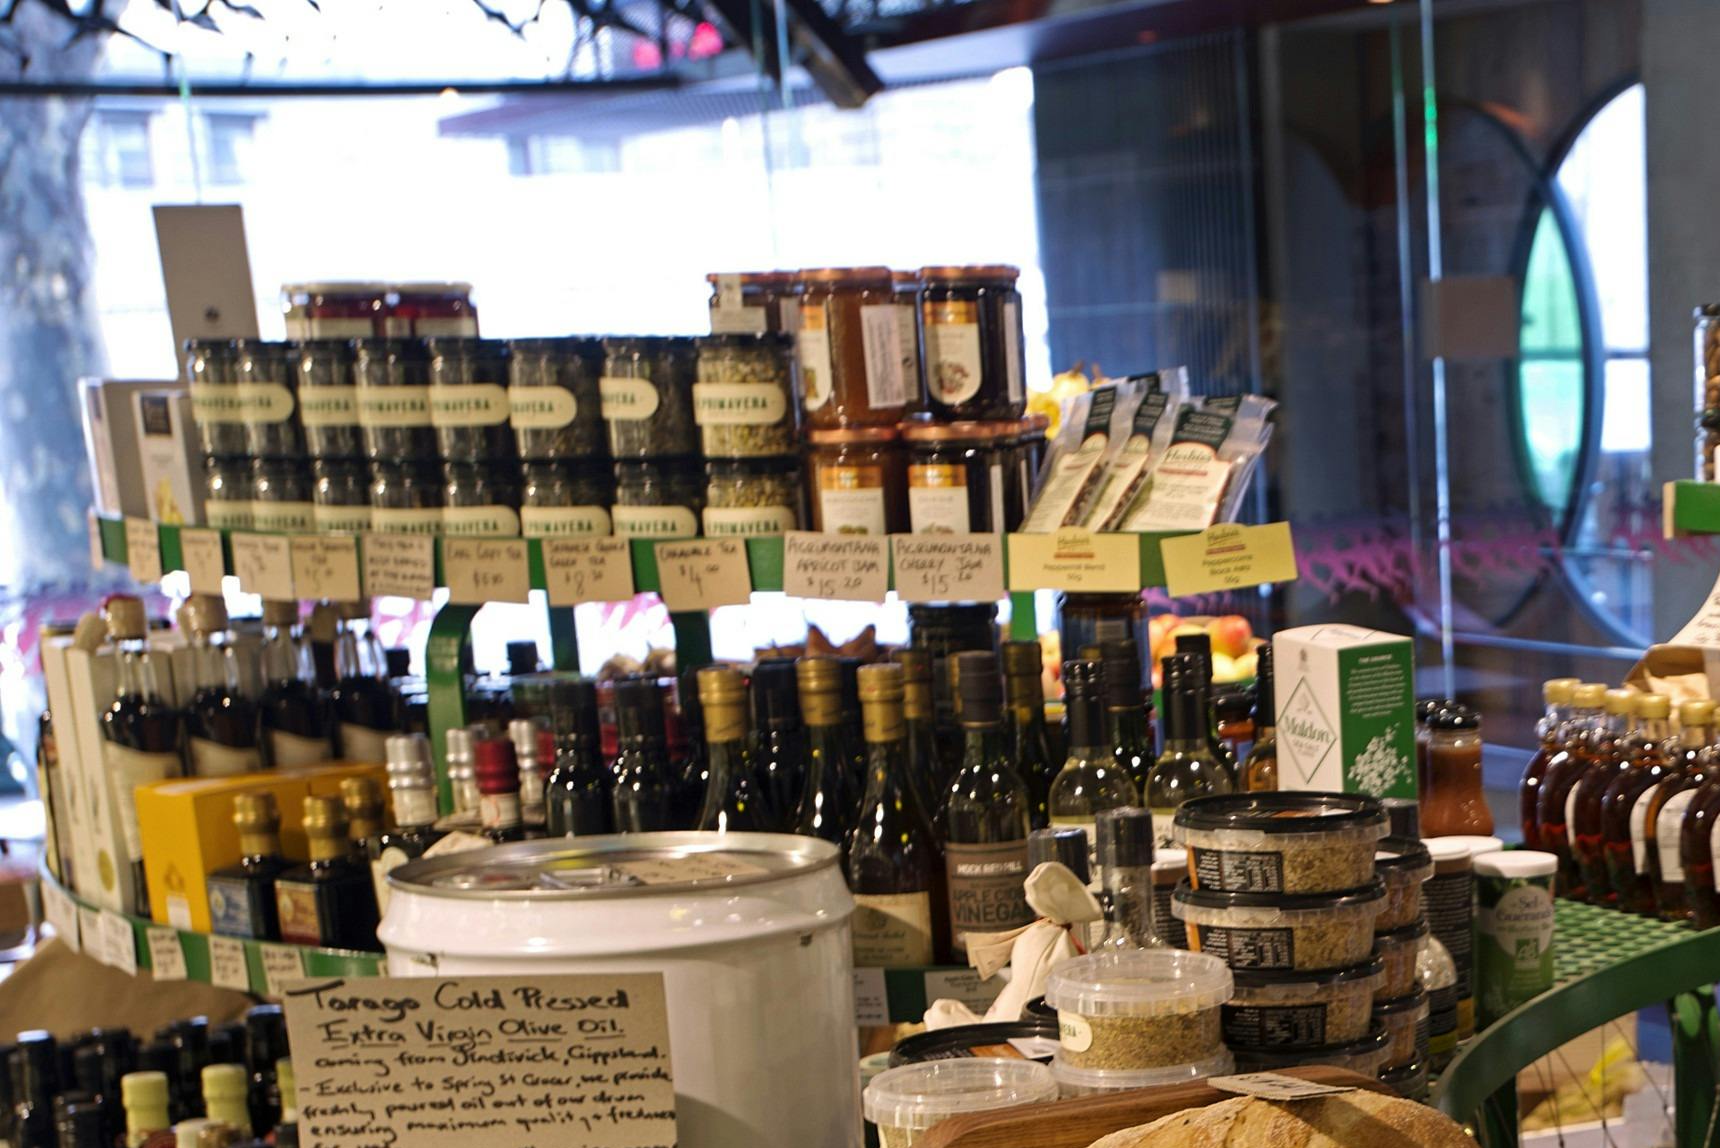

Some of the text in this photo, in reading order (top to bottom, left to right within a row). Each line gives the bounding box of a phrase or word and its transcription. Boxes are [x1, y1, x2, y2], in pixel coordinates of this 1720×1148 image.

[286, 979, 630, 1022] Tarago Cold Pressed
[317, 1018, 406, 1046] Extra
[415, 1020, 493, 1050] Virgin
[498, 1018, 568, 1038] Olive
[397, 1049, 446, 1068] from
[315, 1080, 405, 1097] Exclusive
[411, 1076, 435, 1091] to
[441, 1075, 496, 1097] Spring
[302, 1102, 377, 1122] freshly
[384, 1096, 456, 1118] poured
[460, 1094, 487, 1111] oil
[492, 1092, 530, 1109] out
[532, 1088, 554, 1110] of
[309, 1121, 398, 1144] ensuring
[405, 1115, 508, 1134] maximum
